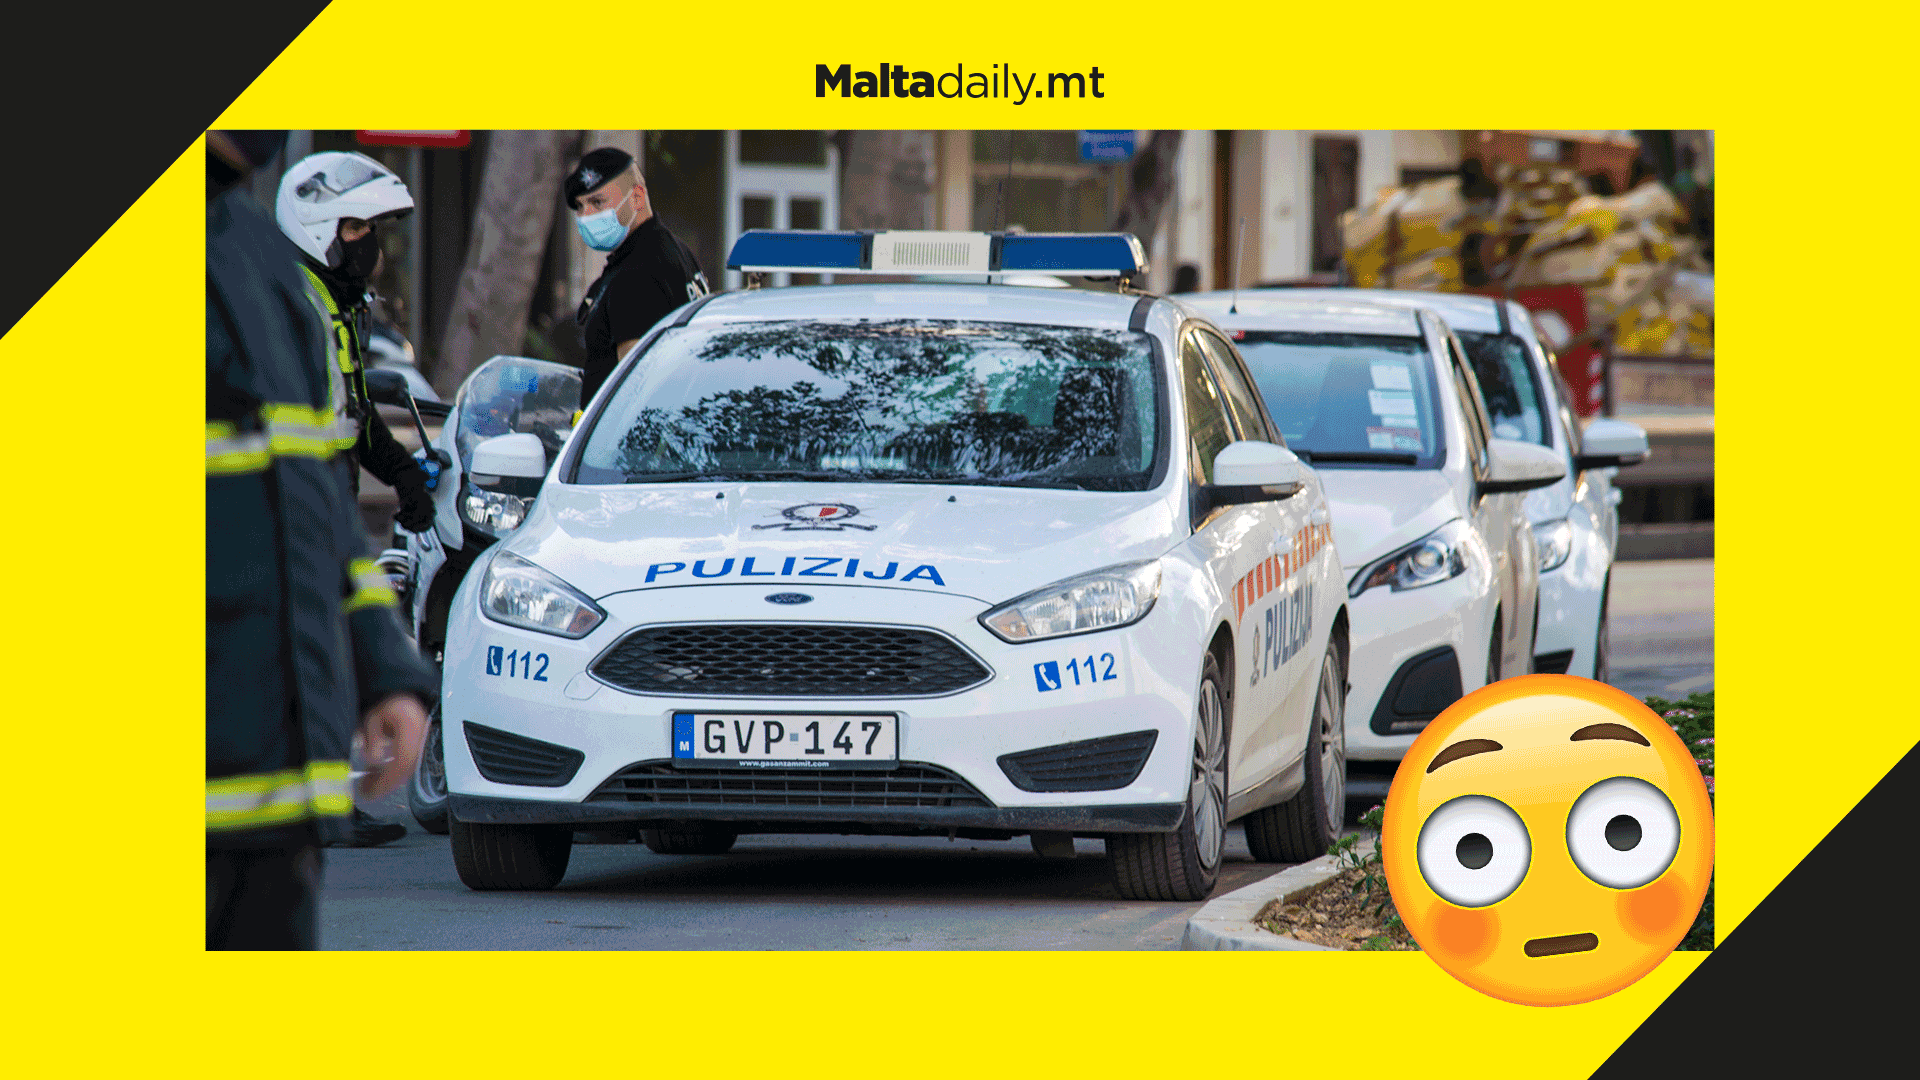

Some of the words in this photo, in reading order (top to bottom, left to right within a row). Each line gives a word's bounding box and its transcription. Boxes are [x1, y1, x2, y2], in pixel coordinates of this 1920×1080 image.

[644, 556, 946, 587] PULIZIJA
[1263, 581, 1313, 678] PULIZIJA
[507, 649, 549, 682] 112
[1066, 652, 1117, 686] 112
[679, 741, 690, 751] M
[739, 759, 830, 768] www.gasanzammit.com
